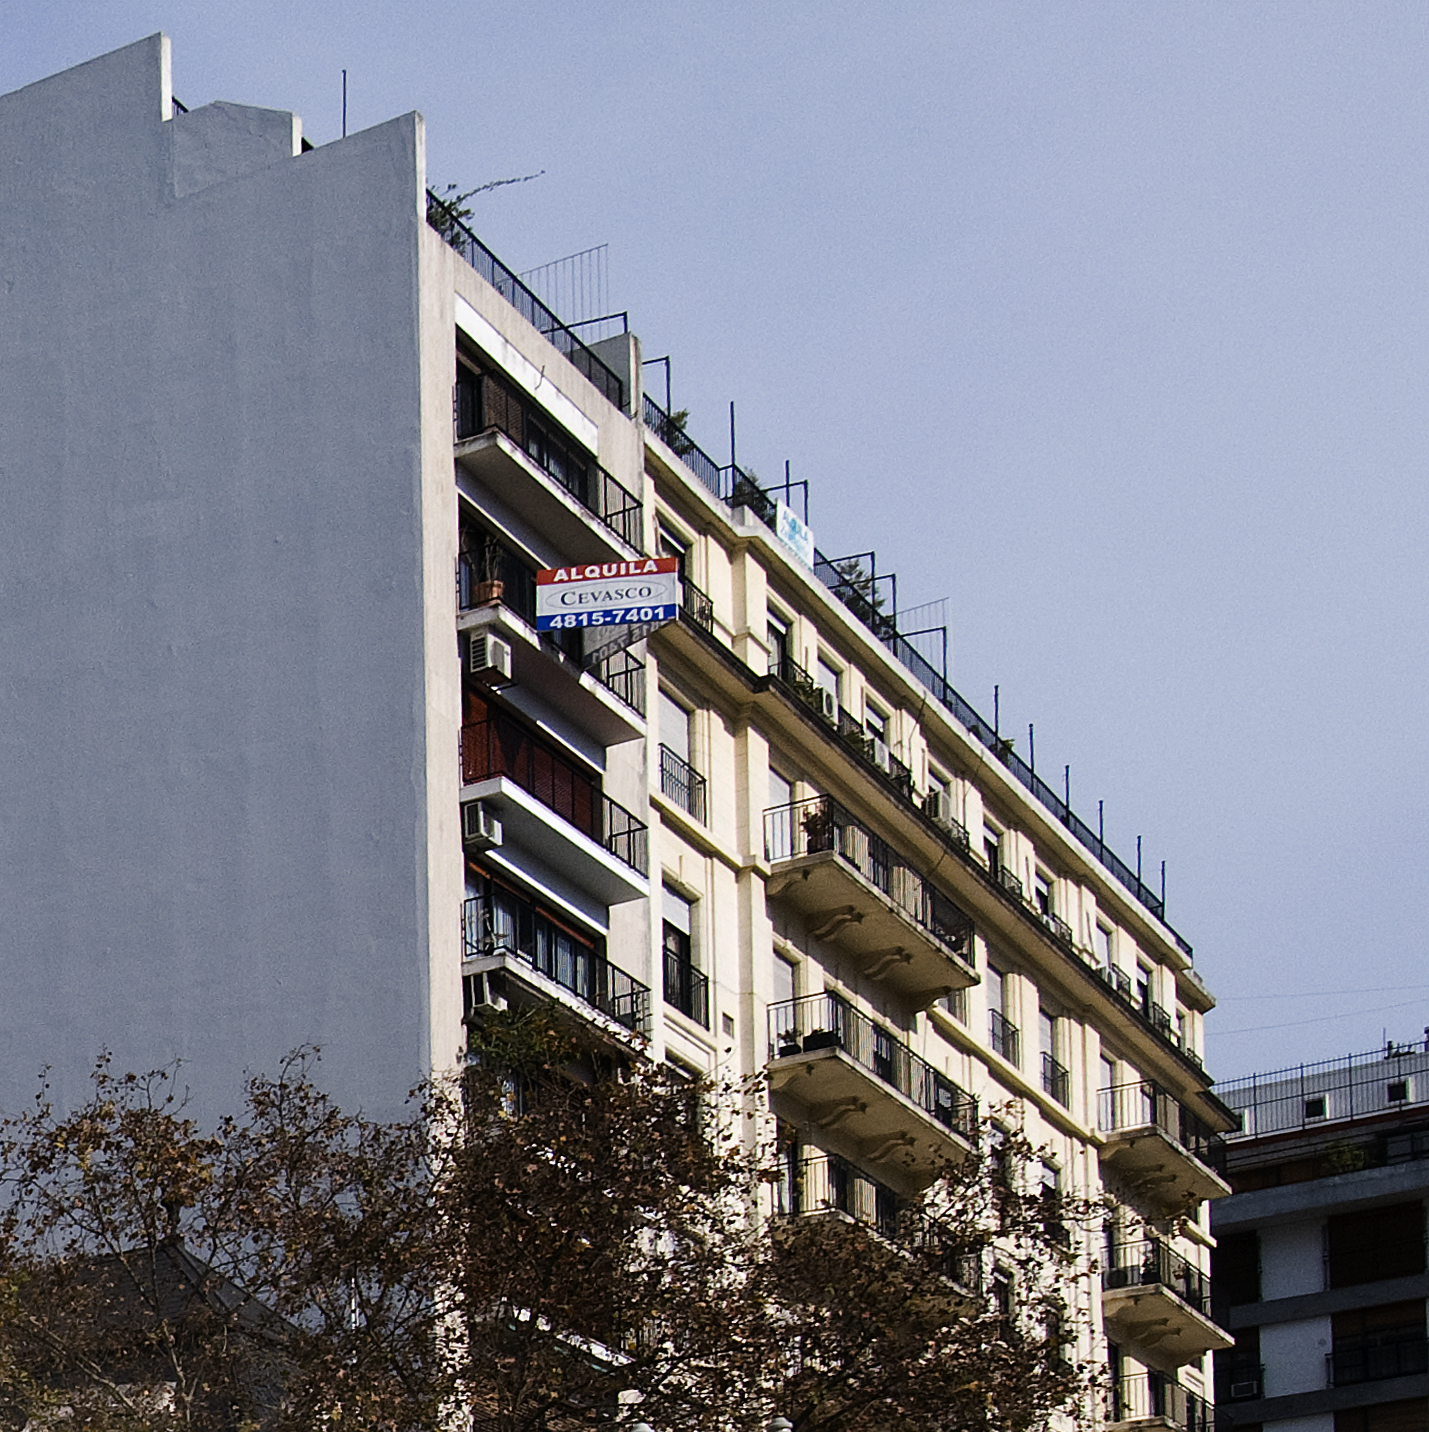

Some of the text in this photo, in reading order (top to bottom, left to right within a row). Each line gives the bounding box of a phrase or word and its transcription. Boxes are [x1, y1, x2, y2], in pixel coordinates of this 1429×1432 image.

[553, 560, 658, 582] ALQUILA
[560, 586, 652, 606] CEVASCO
[549, 606, 665, 629] 4815-7401
